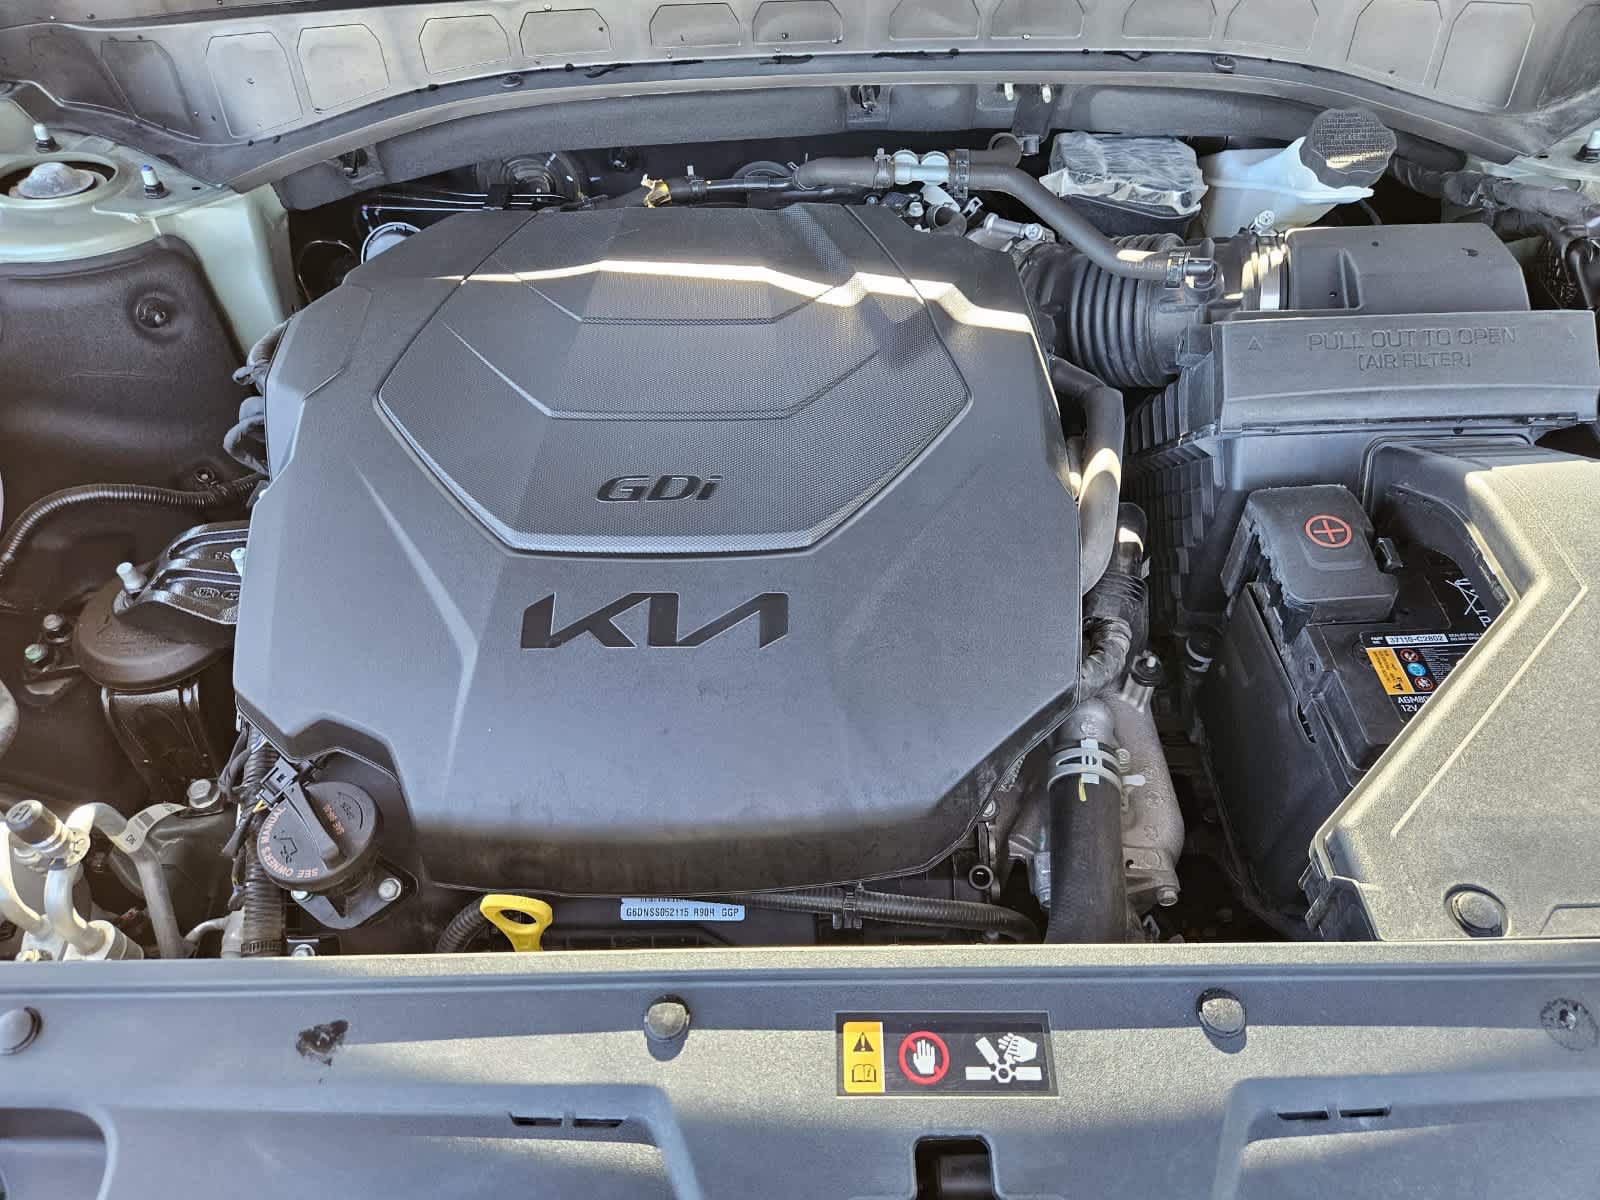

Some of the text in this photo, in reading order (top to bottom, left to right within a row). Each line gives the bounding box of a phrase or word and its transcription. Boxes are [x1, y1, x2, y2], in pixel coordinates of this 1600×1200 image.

[1309, 327, 1515, 350] PULL OUT TO OPEN
[596, 474, 722, 502] GDi
[520, 592, 789, 650] KIA
[297, 867, 319, 879] SEE
